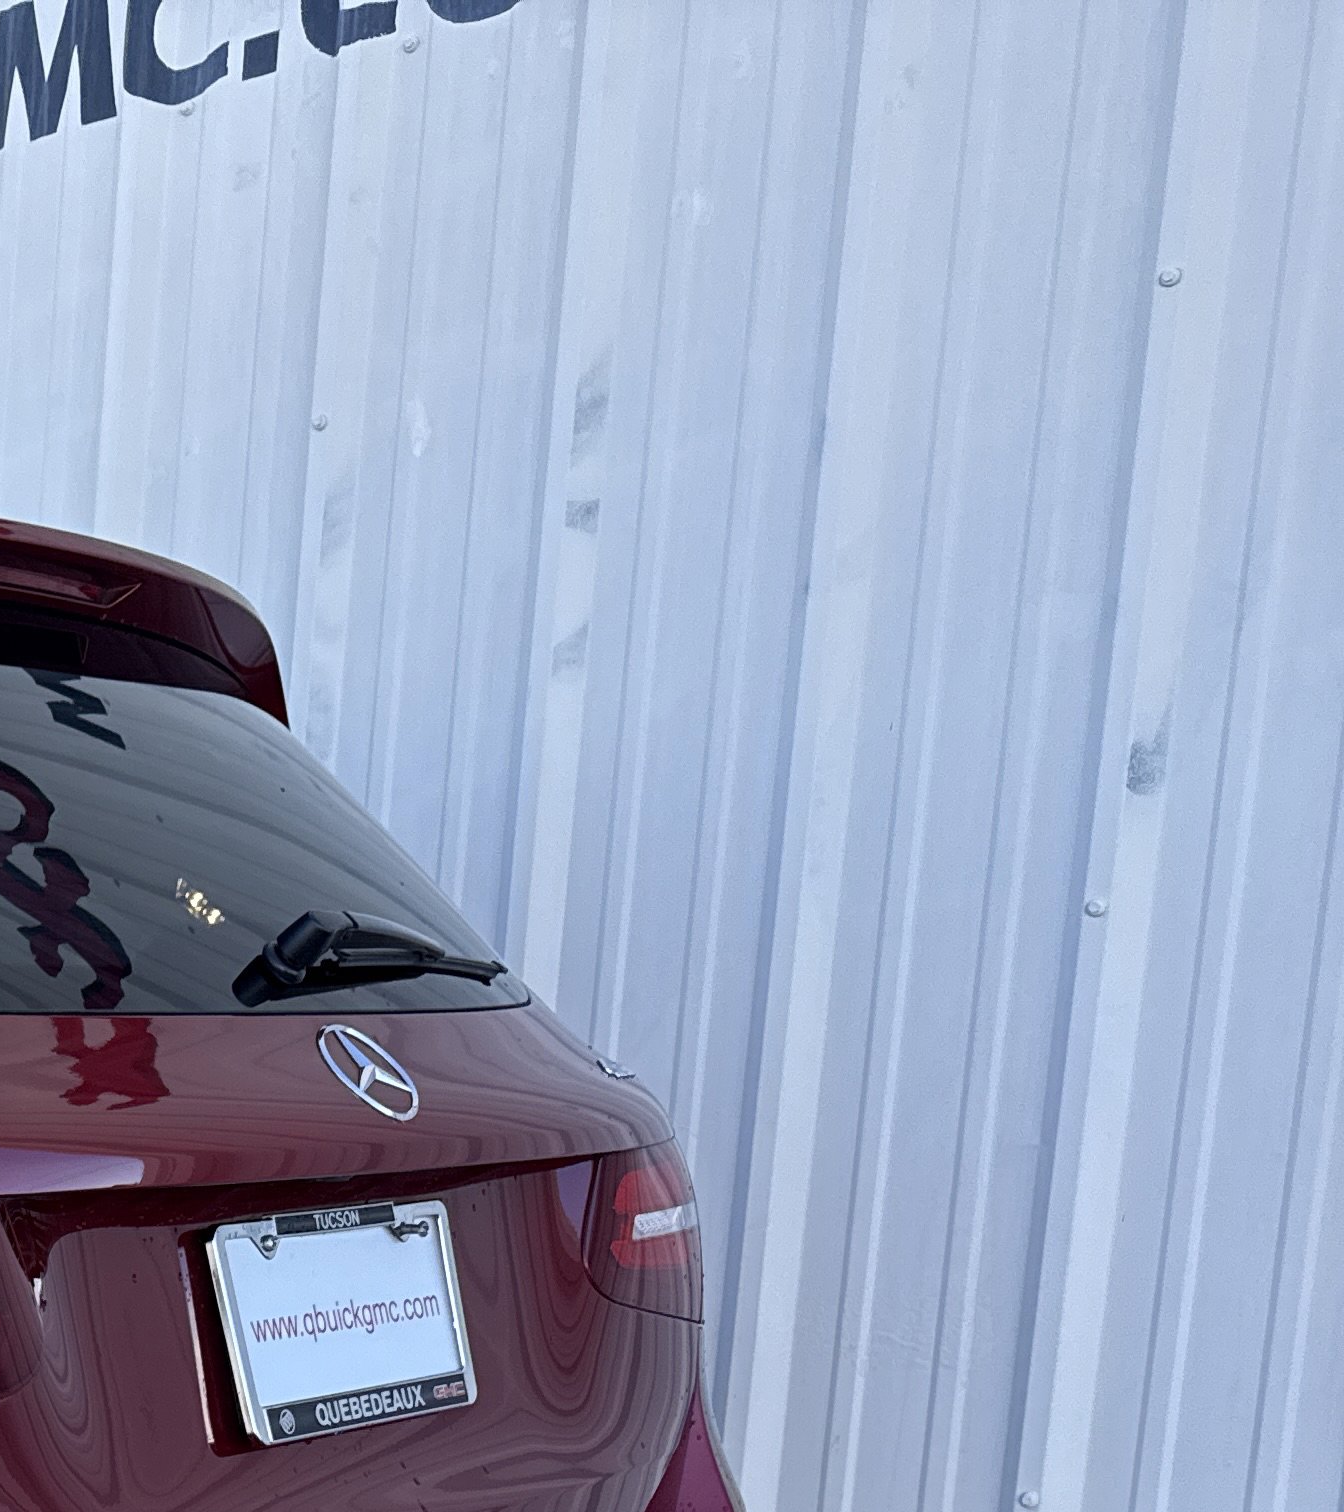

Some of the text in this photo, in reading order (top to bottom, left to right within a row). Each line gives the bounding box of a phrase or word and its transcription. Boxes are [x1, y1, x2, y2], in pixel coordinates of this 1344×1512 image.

[312, 1210, 361, 1231] TUCSON
[250, 1294, 441, 1343] www.qbuickgmc.com
[315, 1384, 427, 1427] QUEBEDEAUX
[432, 1380, 467, 1400] GMC
